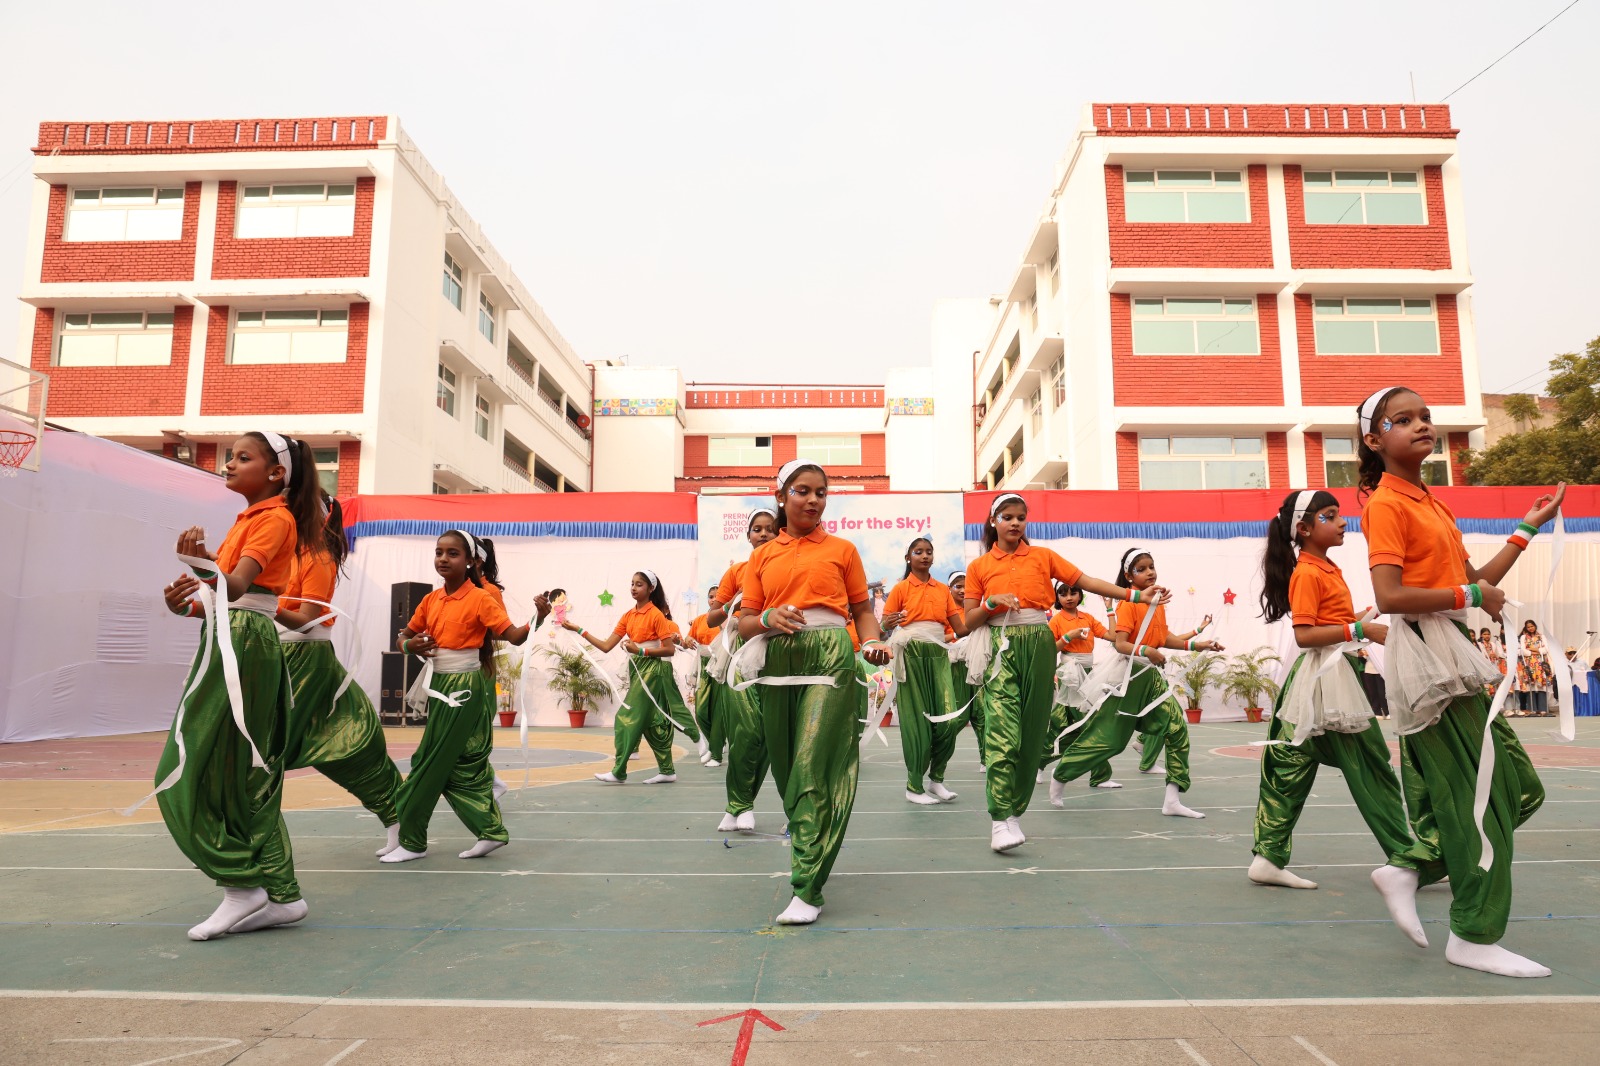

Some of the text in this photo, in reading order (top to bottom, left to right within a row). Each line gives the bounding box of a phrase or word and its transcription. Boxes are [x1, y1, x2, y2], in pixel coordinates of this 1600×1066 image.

[821, 516, 931, 534] ng for the Sky!
[723, 533, 740, 541] DAY
